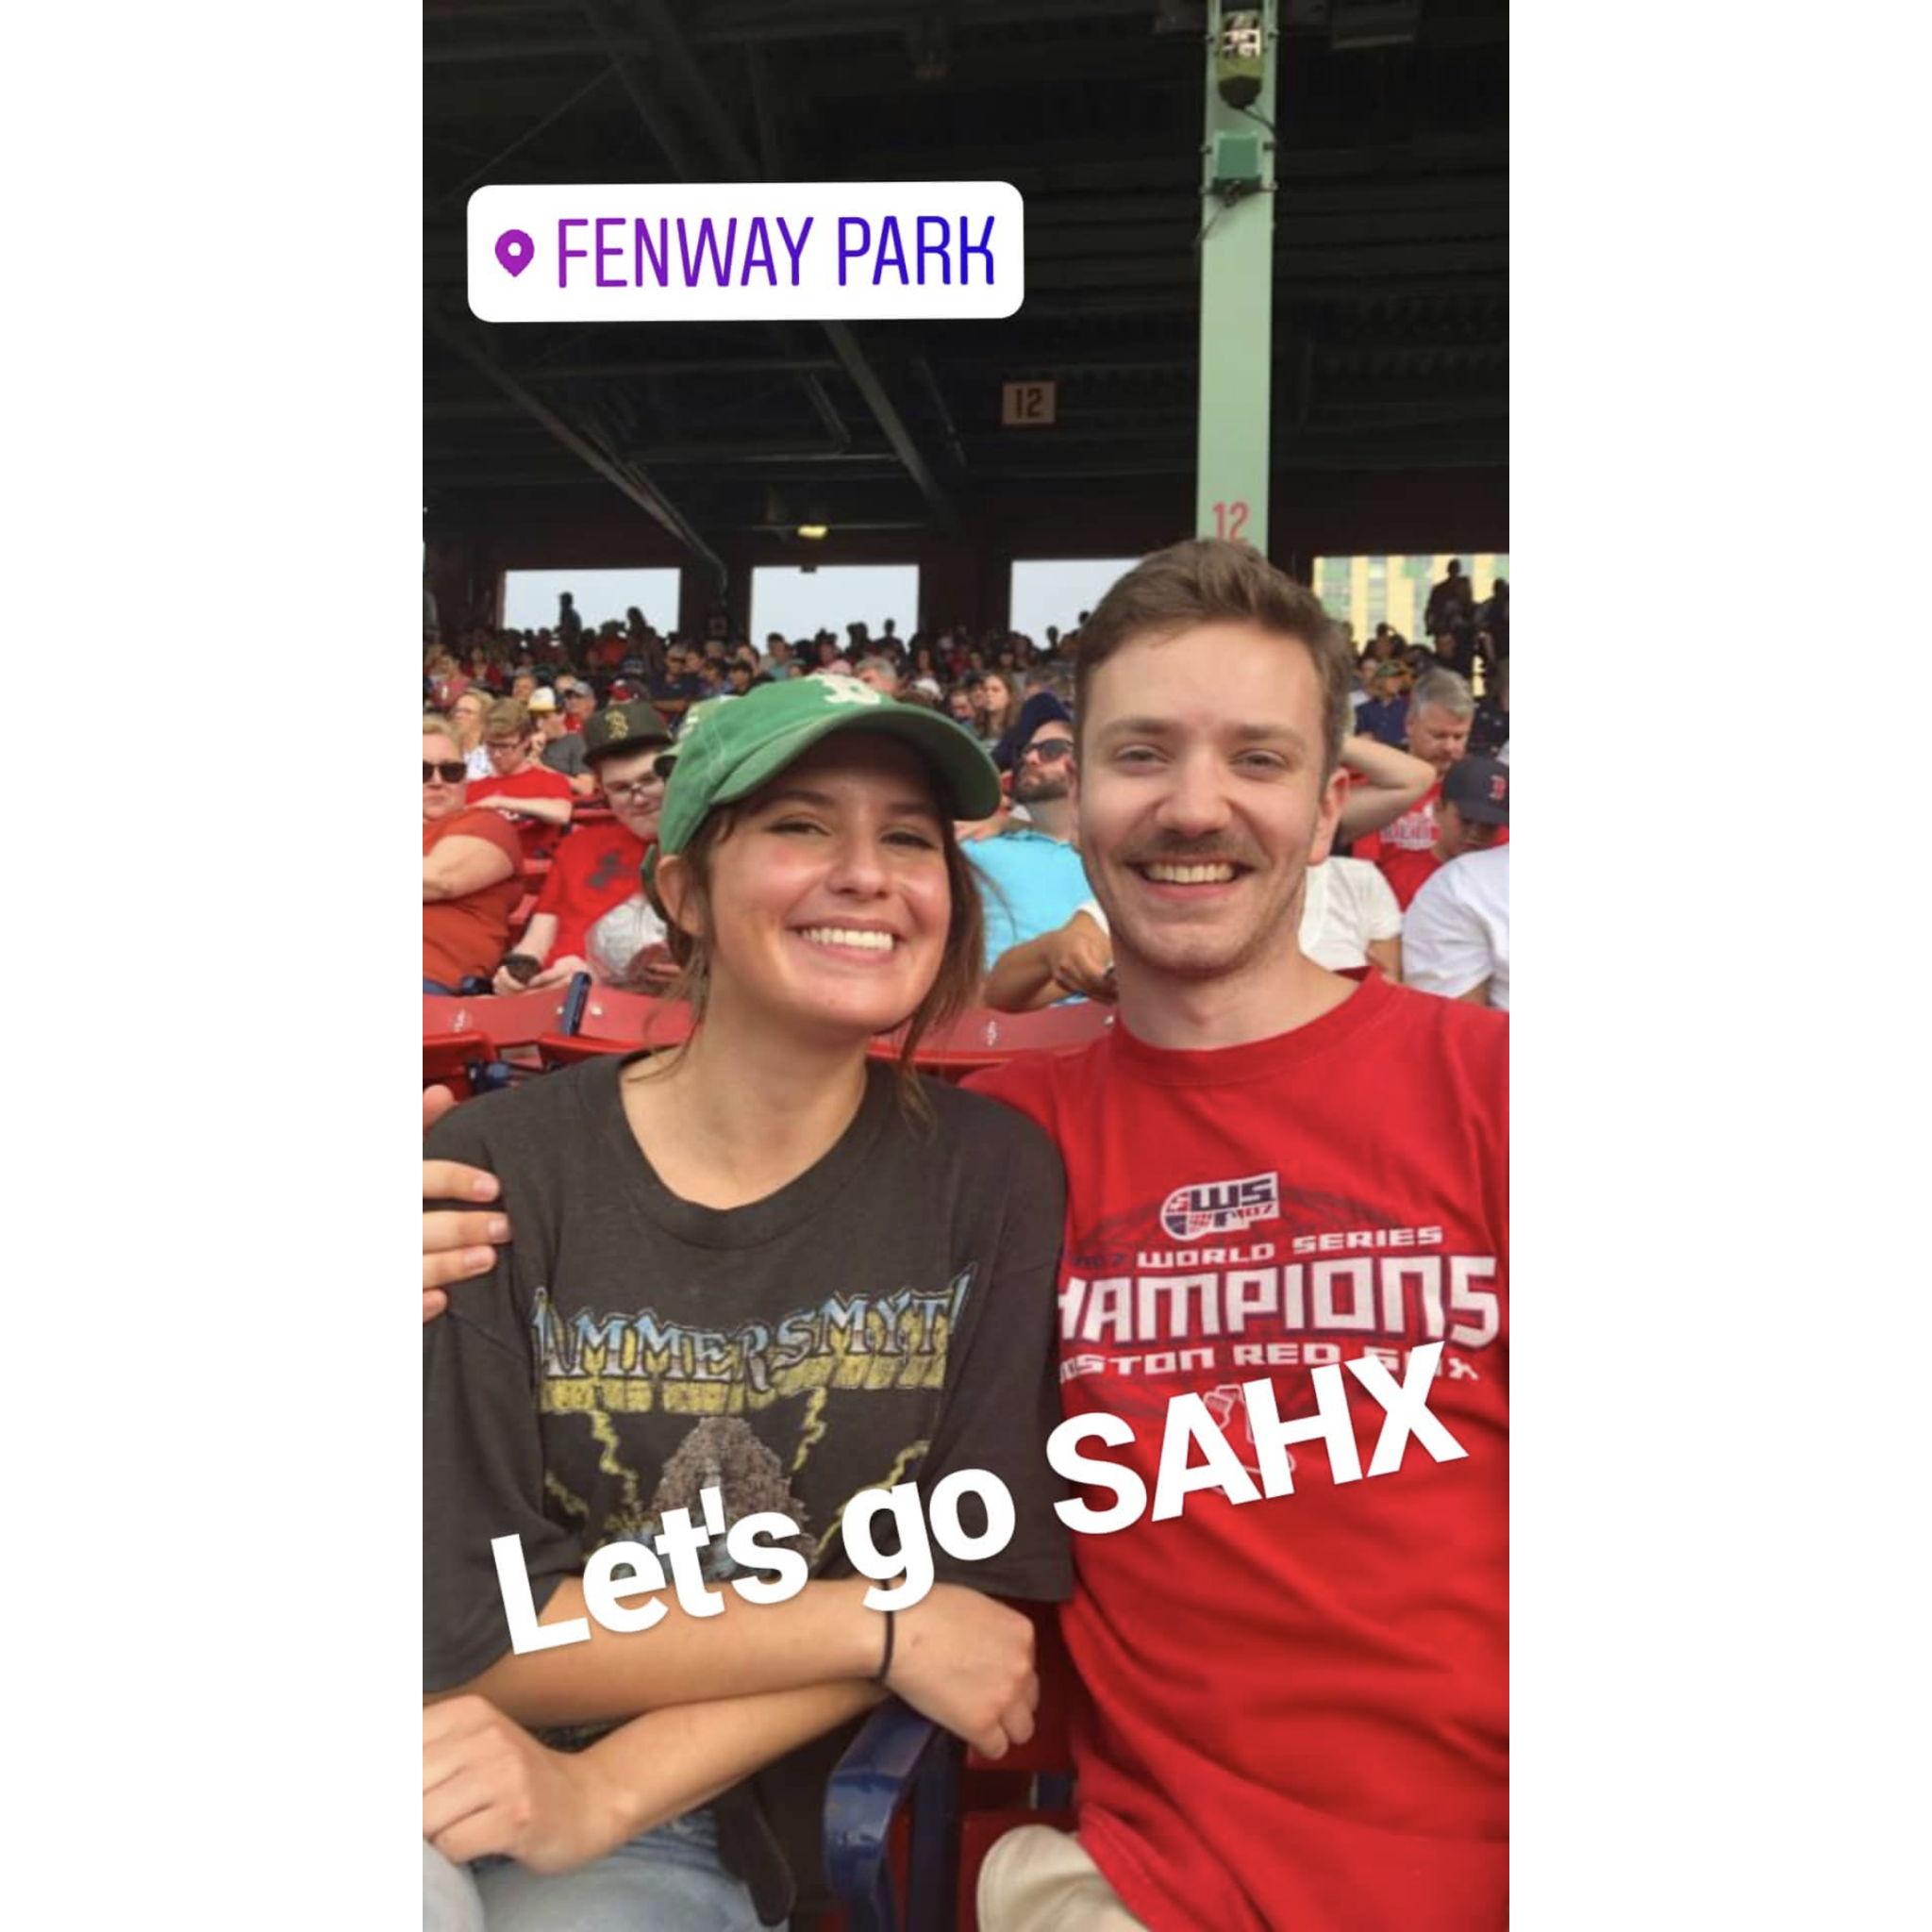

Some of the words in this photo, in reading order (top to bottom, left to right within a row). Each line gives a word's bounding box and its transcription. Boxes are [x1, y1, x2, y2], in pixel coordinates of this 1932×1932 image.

[1015, 387, 1044, 419] 12
[1213, 501, 1250, 541] 12
[1190, 1177, 1276, 1217] WS
[1136, 1242, 1275, 1269] WORLD
[1292, 1225, 1443, 1256] SERIES
[1058, 1255, 1500, 1348] HAMPIONS
[531, 1267, 974, 1392] AMMERSMYT
[1060, 1347, 1215, 1384] OSTON
[1233, 1342, 1341, 1367] RED
